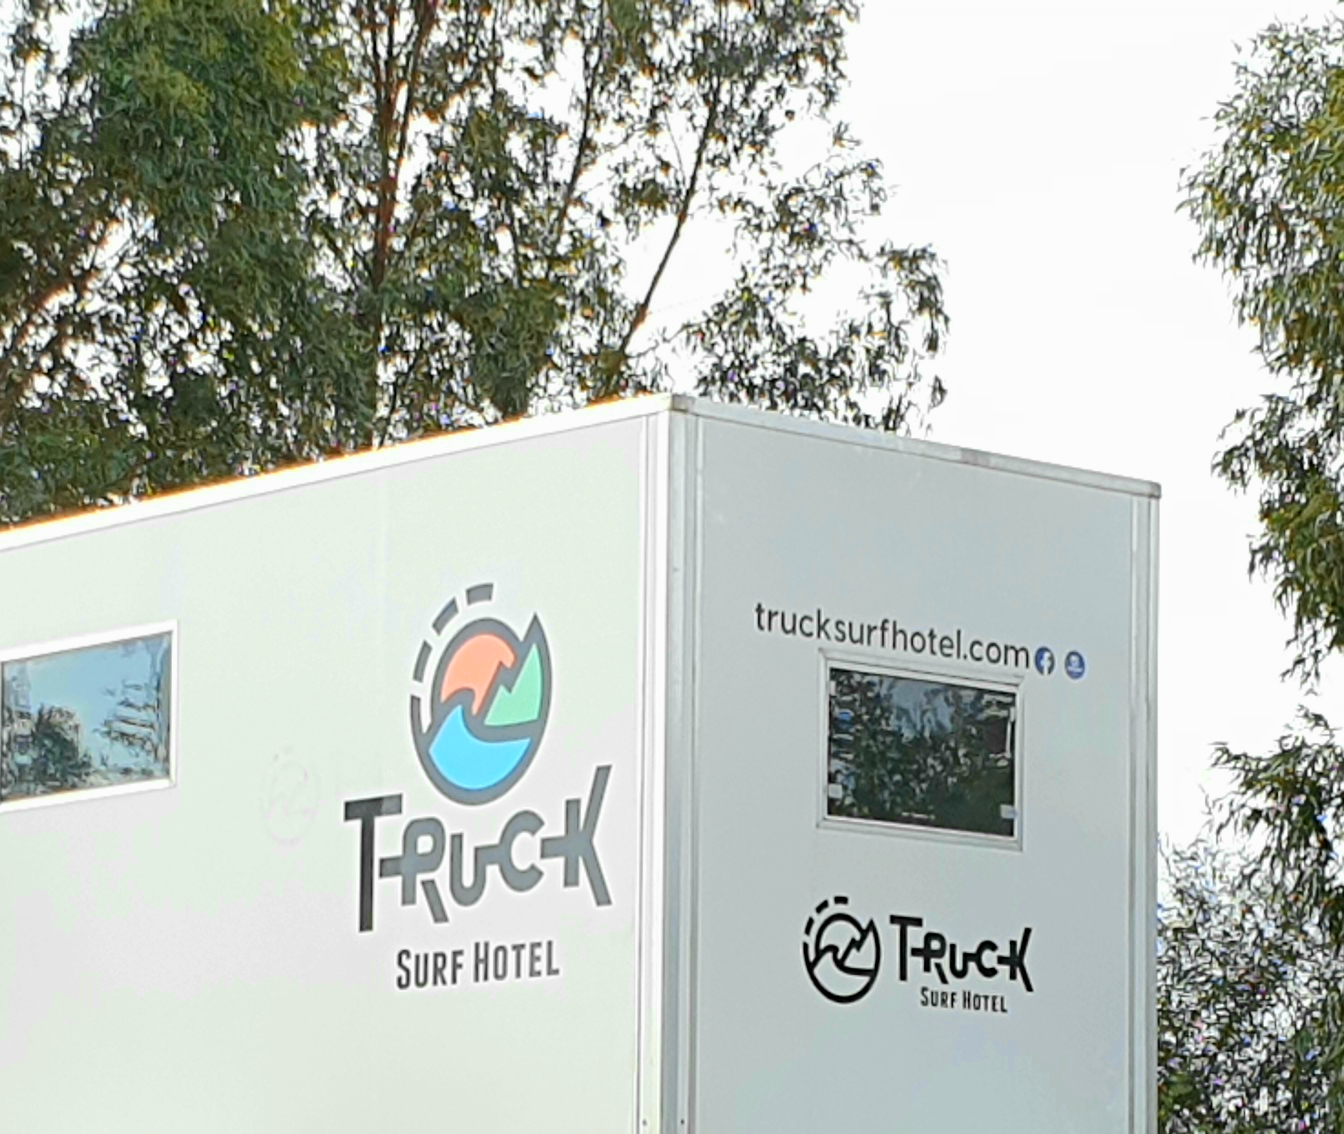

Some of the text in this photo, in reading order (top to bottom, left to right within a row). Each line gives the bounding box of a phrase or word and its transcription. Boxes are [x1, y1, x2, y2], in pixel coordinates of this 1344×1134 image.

[754, 602, 1030, 668] trucksurfhotel.com
[396, 940, 560, 989] SURF HOTEL
[920, 986, 1008, 1013] SURF HOTEL
